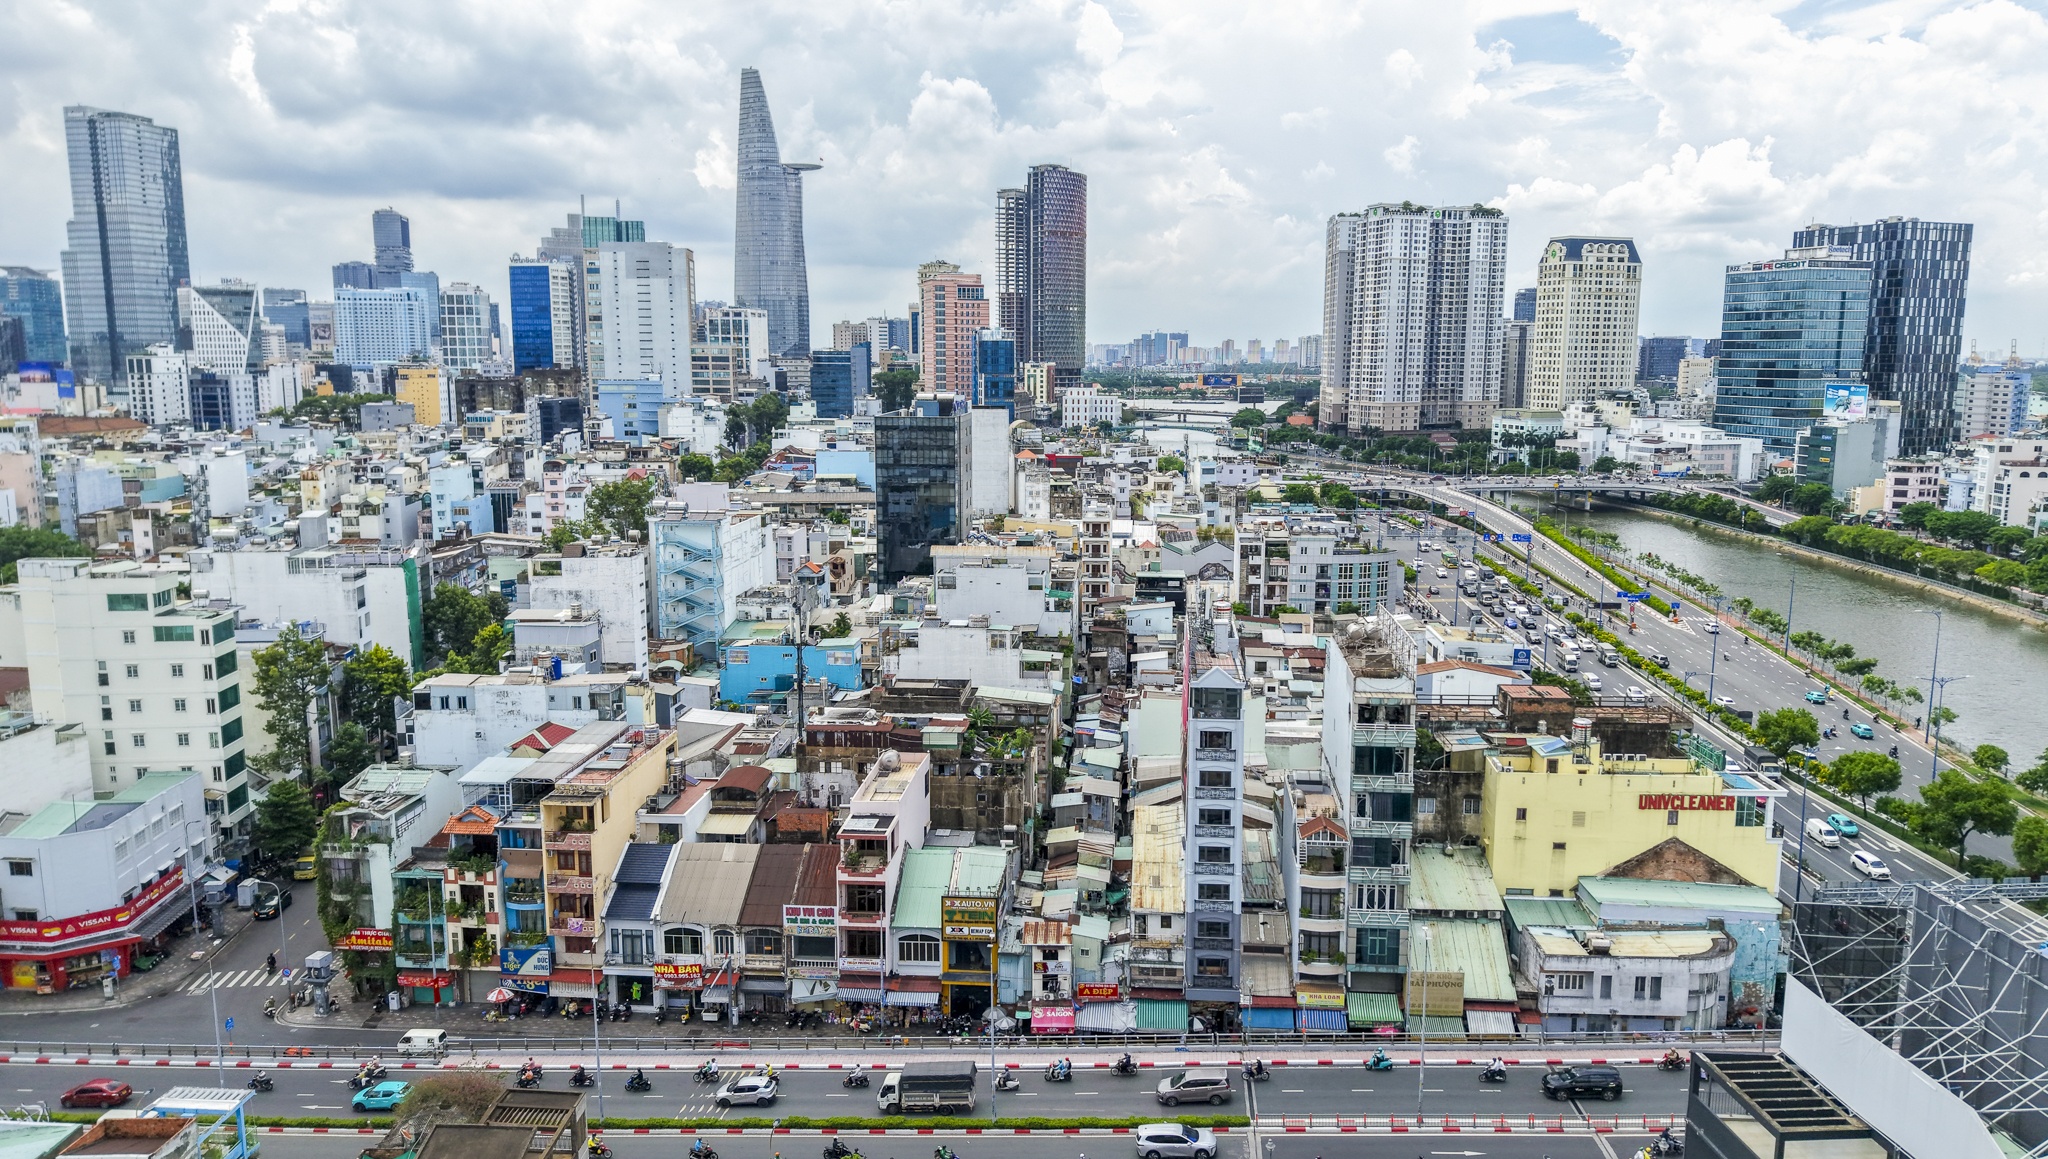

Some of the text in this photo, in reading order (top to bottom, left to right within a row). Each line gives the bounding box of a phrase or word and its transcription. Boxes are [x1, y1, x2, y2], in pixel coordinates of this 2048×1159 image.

[1774, 261, 1806, 269] CREDIT
[1639, 794, 1735, 810] UNIVCLEANER
[786, 907, 834, 918] KHU VUI CHƠI
[958, 910, 994, 920] TEIN
[78, 916, 111, 928] VISSAN
[503, 962, 521, 971] Tiger
